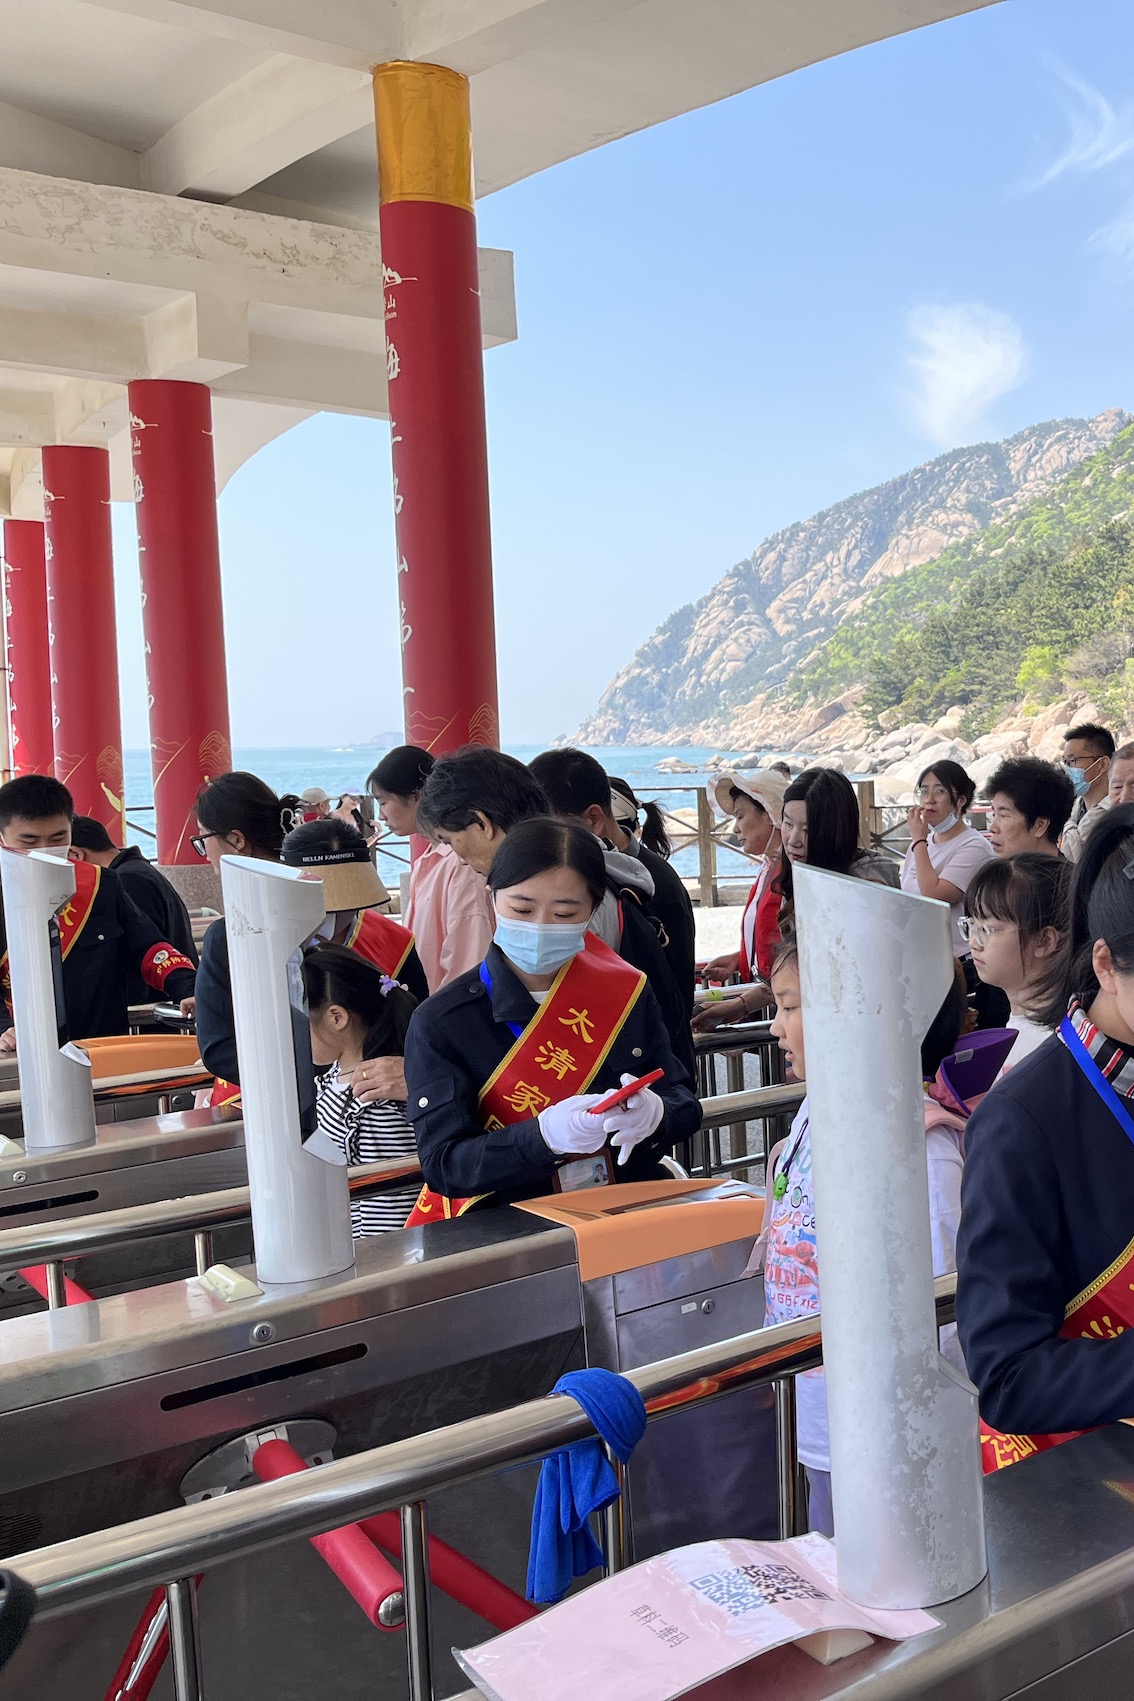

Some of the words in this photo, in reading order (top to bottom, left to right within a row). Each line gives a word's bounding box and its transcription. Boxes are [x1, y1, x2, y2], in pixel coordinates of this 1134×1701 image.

[629, 1603, 690, 1649] 草料二维码
